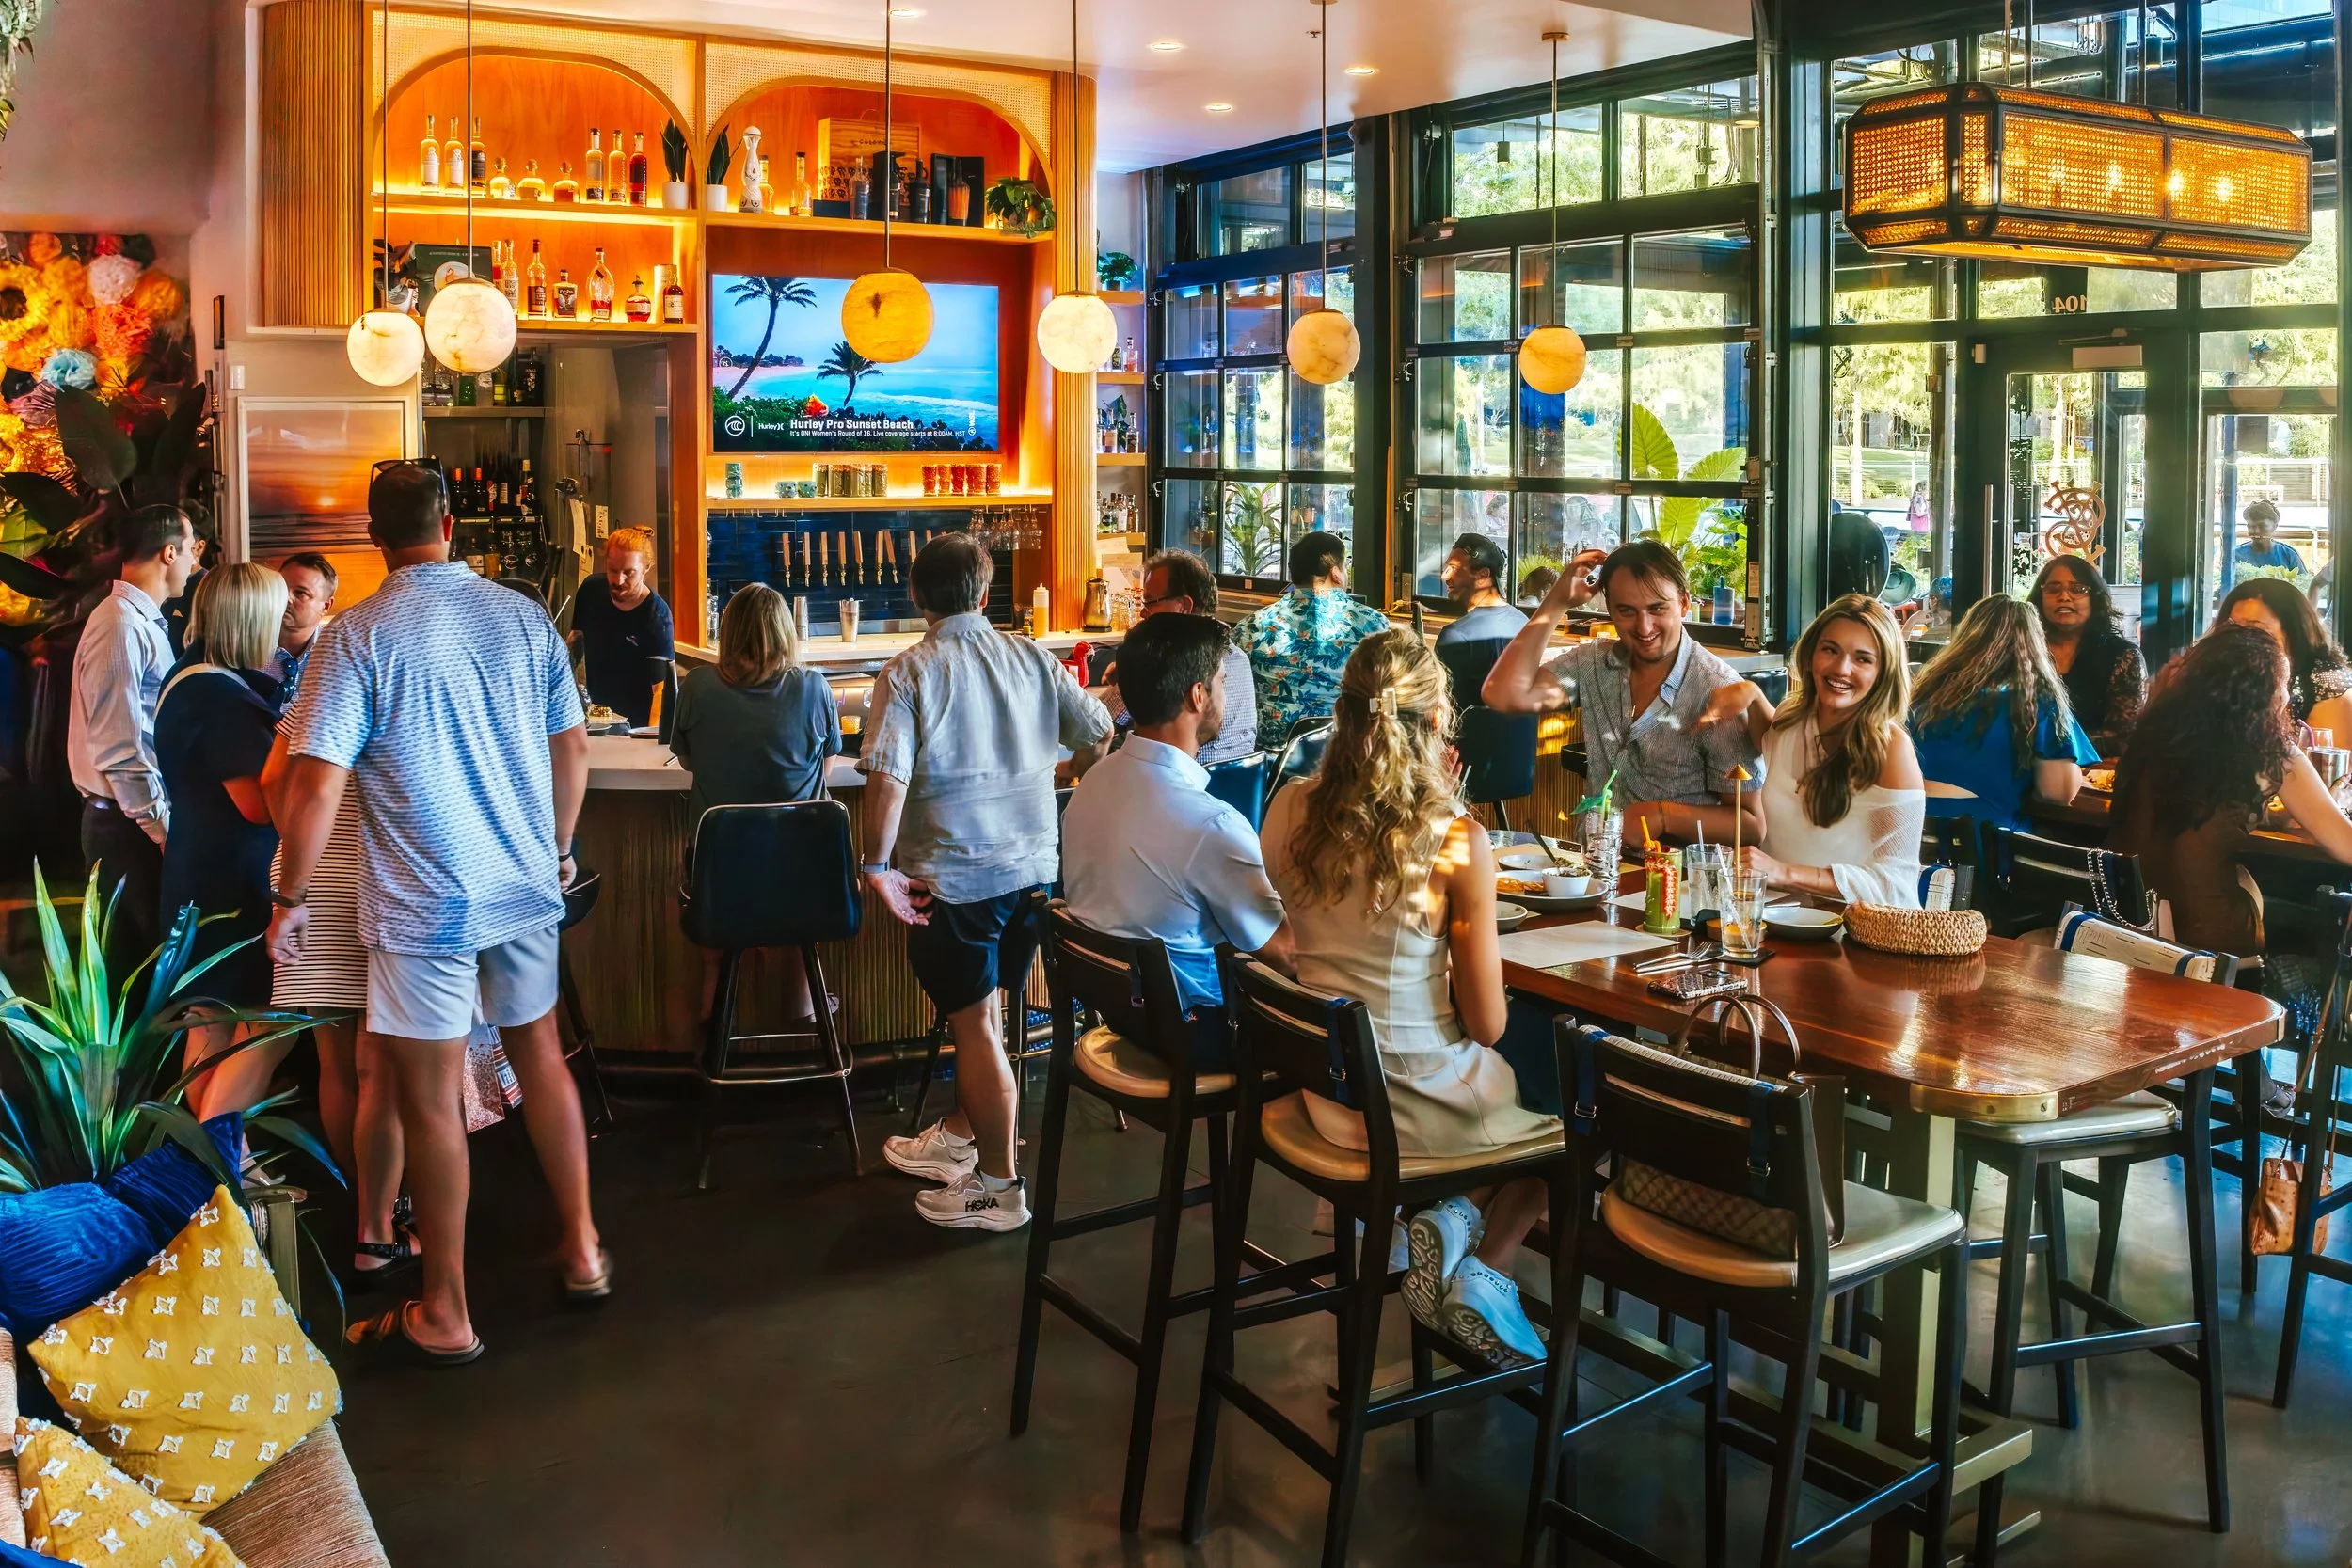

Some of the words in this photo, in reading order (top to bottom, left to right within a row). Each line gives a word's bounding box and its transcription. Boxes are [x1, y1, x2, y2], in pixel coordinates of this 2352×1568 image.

[790, 419, 824, 431] Hurley
[826, 419, 844, 429] Pro
[846, 419, 882, 429] Sunset
[883, 420, 914, 429] Beach
[964, 1197, 1000, 1212] HOKA
